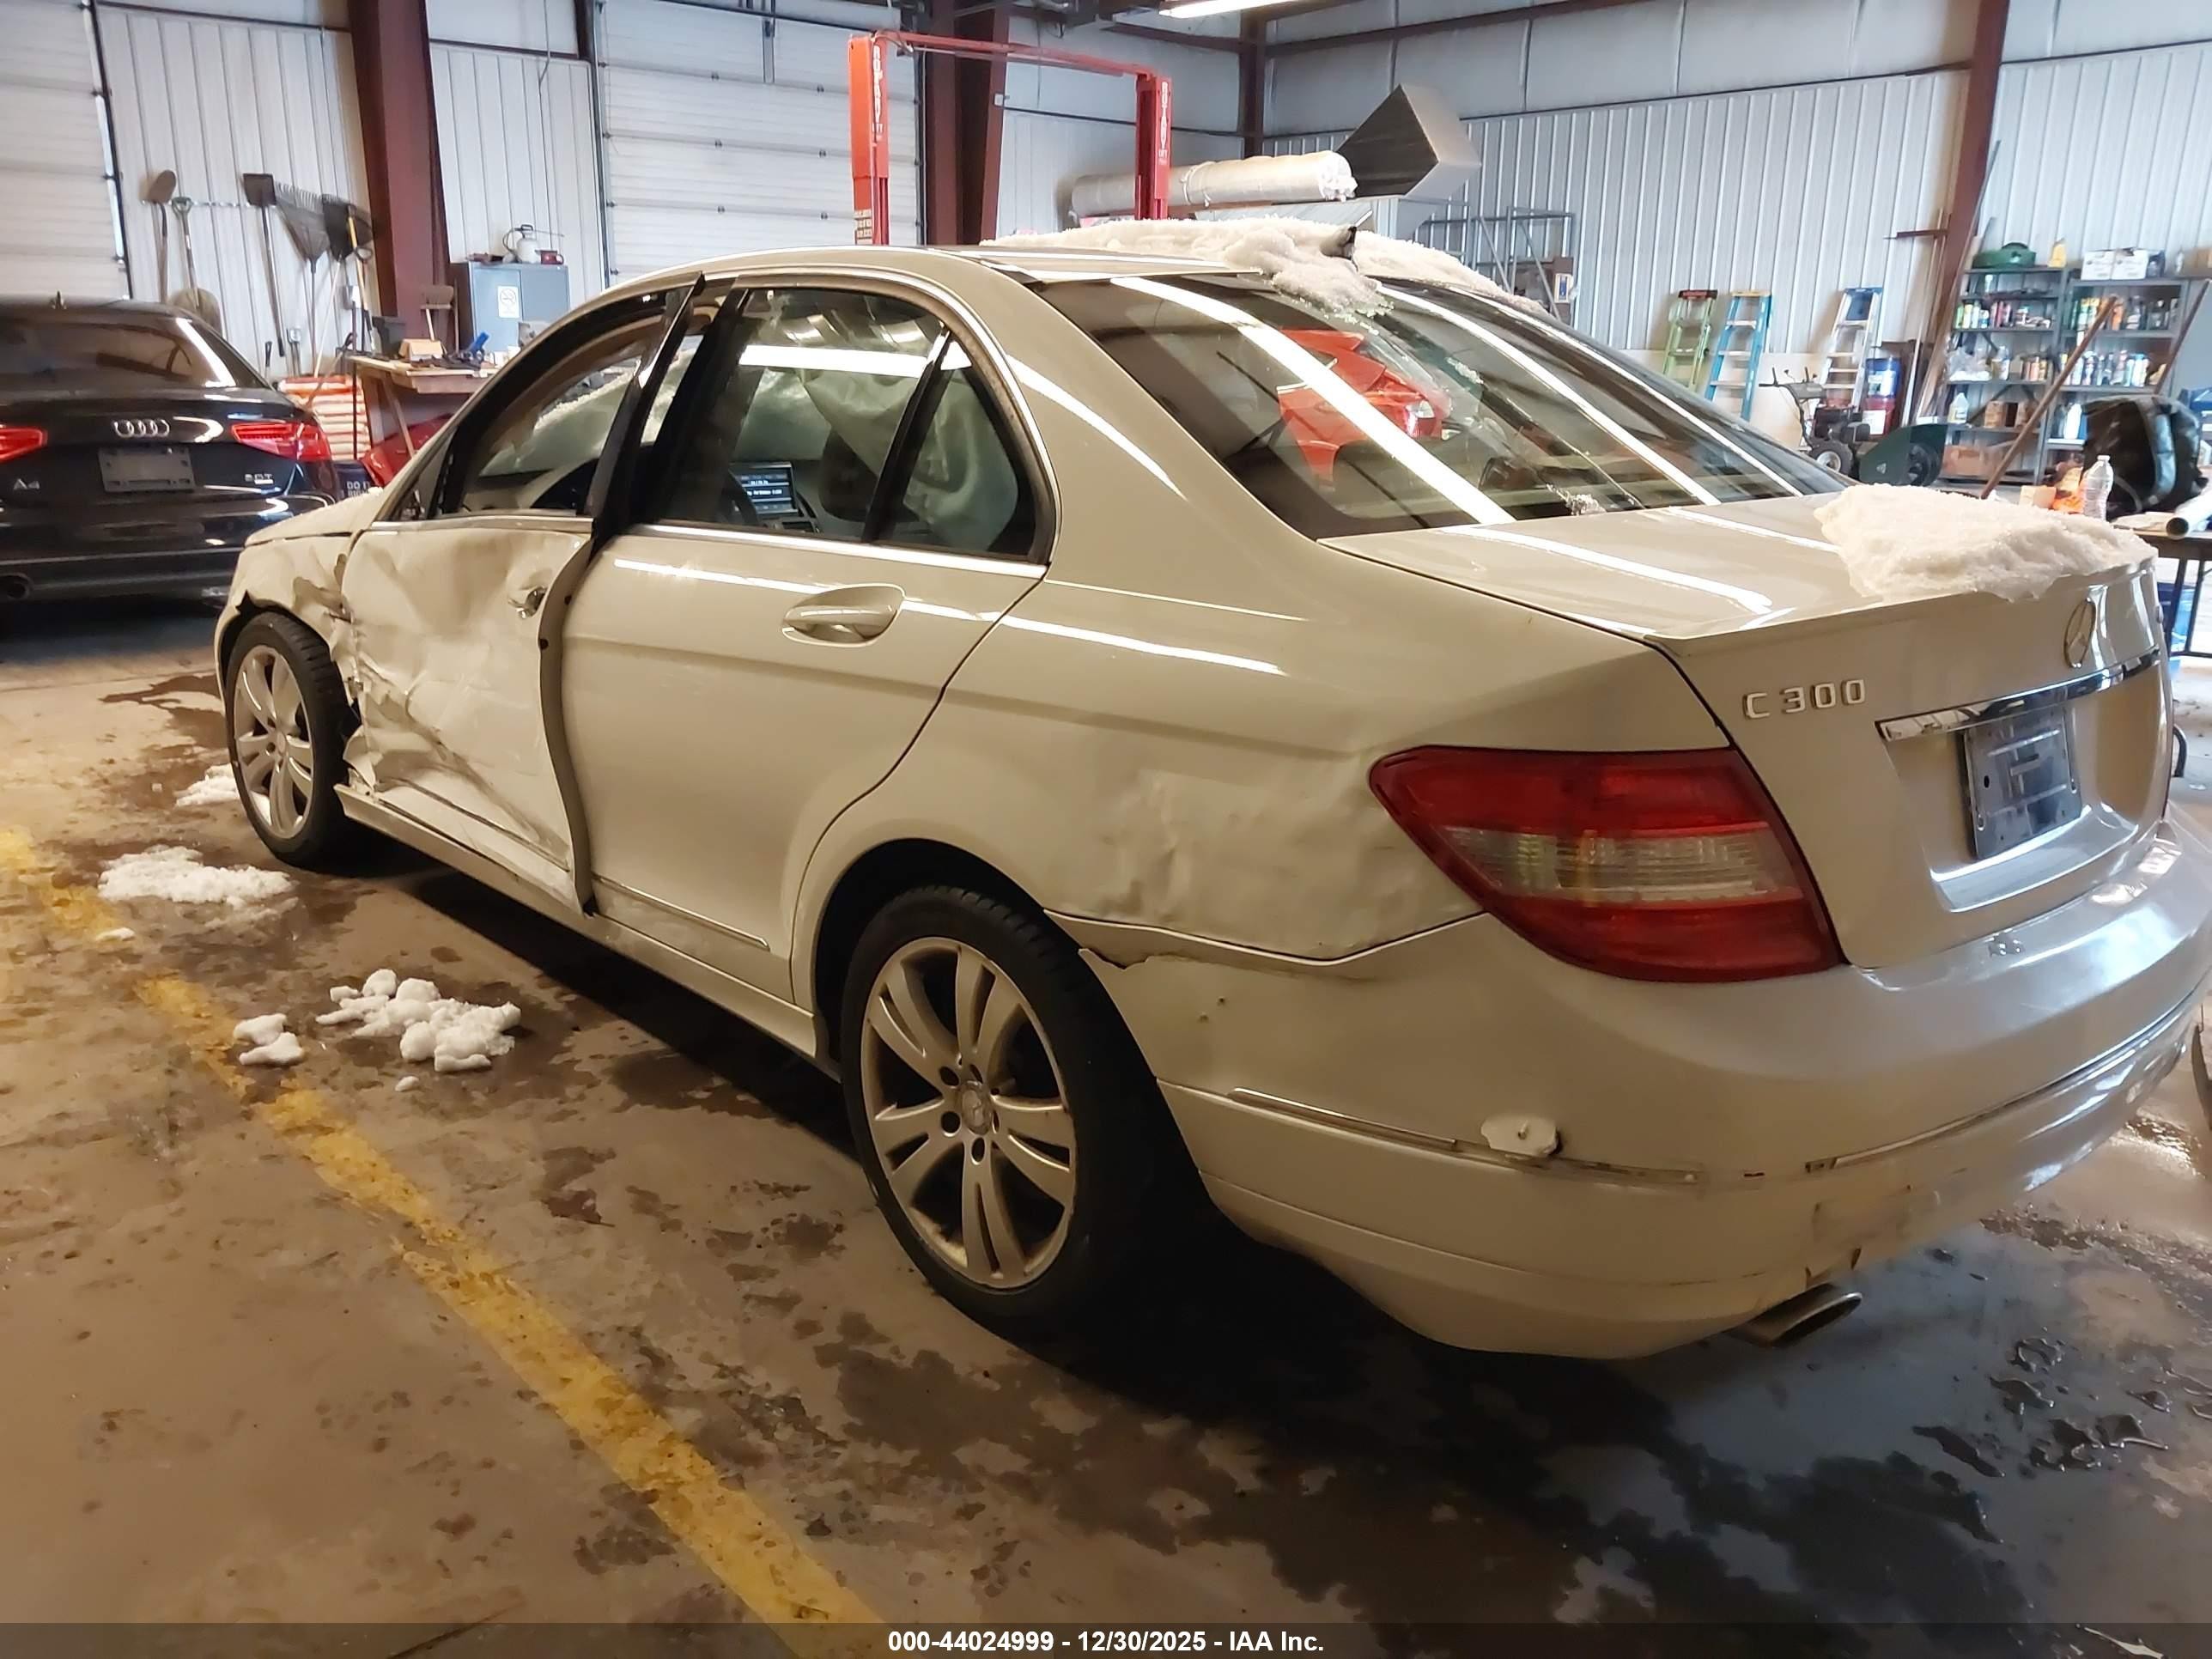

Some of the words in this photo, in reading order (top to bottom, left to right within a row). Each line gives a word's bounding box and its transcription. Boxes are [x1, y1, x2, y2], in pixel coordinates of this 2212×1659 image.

[14, 478, 40, 489] A4
[346, 481, 360, 490] DO
[1743, 692, 1771, 719] C
[1780, 678, 1865, 714] 300
